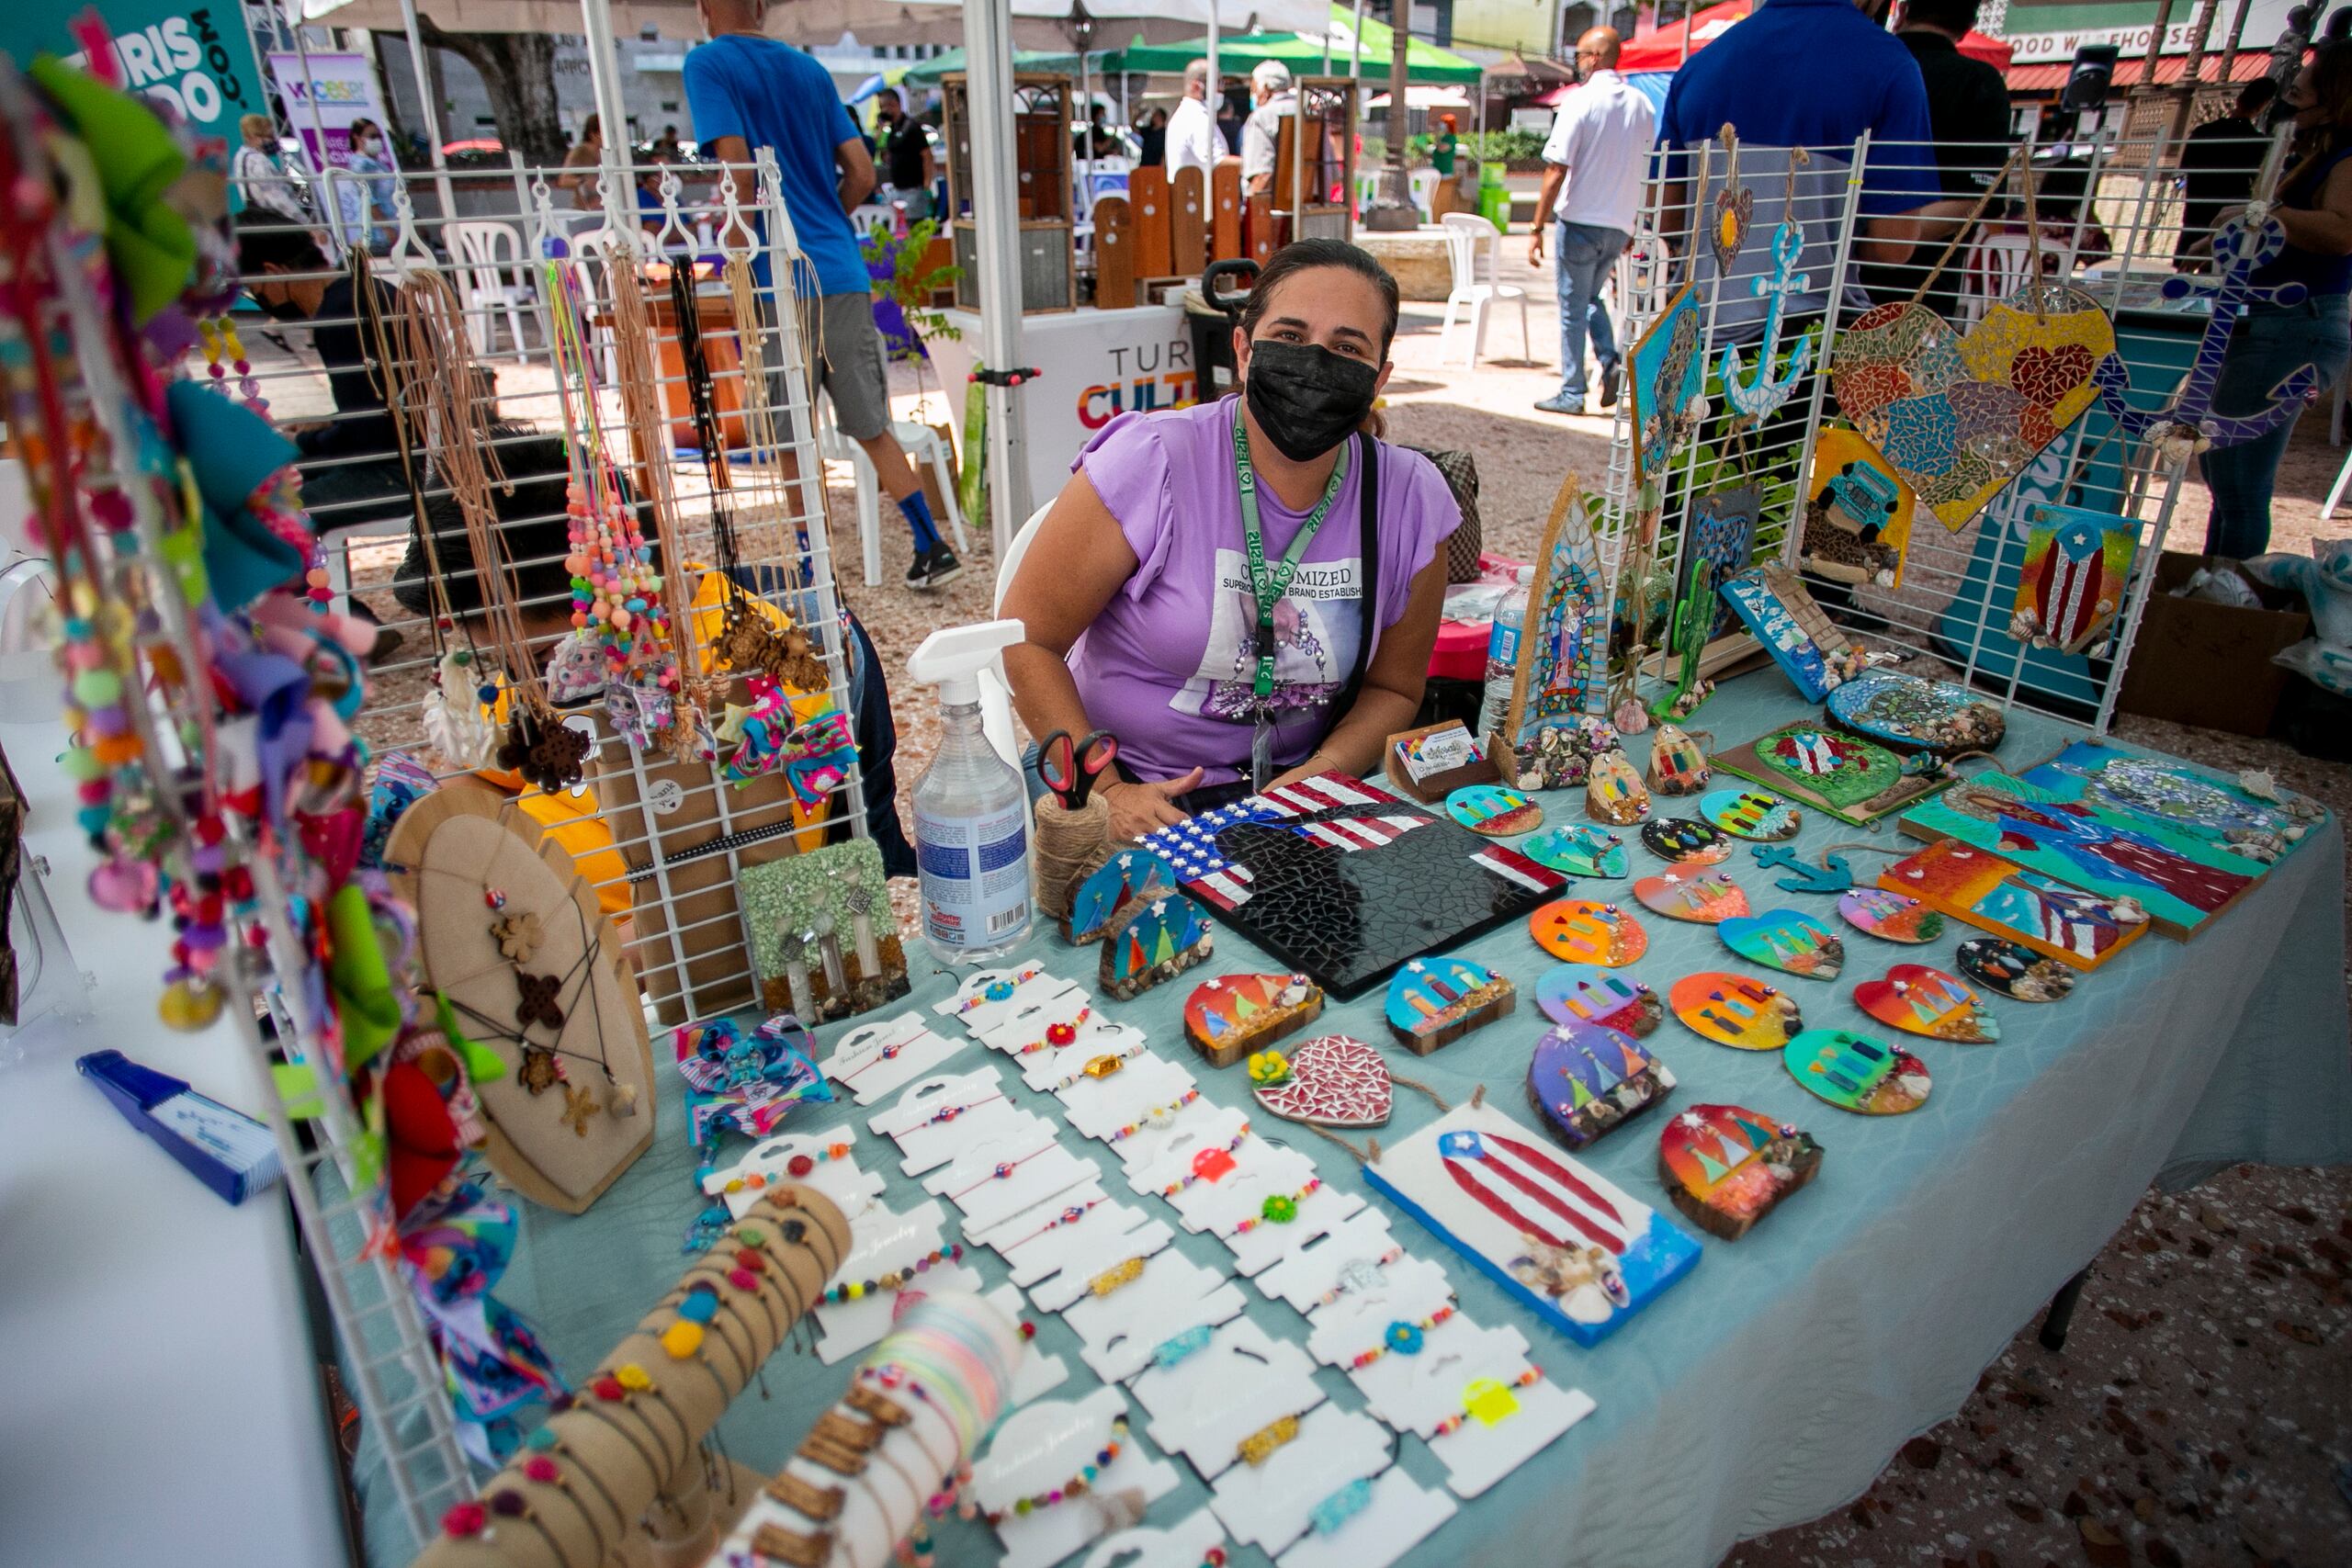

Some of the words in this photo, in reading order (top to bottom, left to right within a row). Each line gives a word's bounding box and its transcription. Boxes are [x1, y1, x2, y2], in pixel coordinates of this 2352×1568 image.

[57, 17, 201, 91] RIS
[2010, 38, 2054, 54] OOD
[2064, 25, 2198, 51] WEHOSE
[1288, 587, 1317, 598] BRAND
